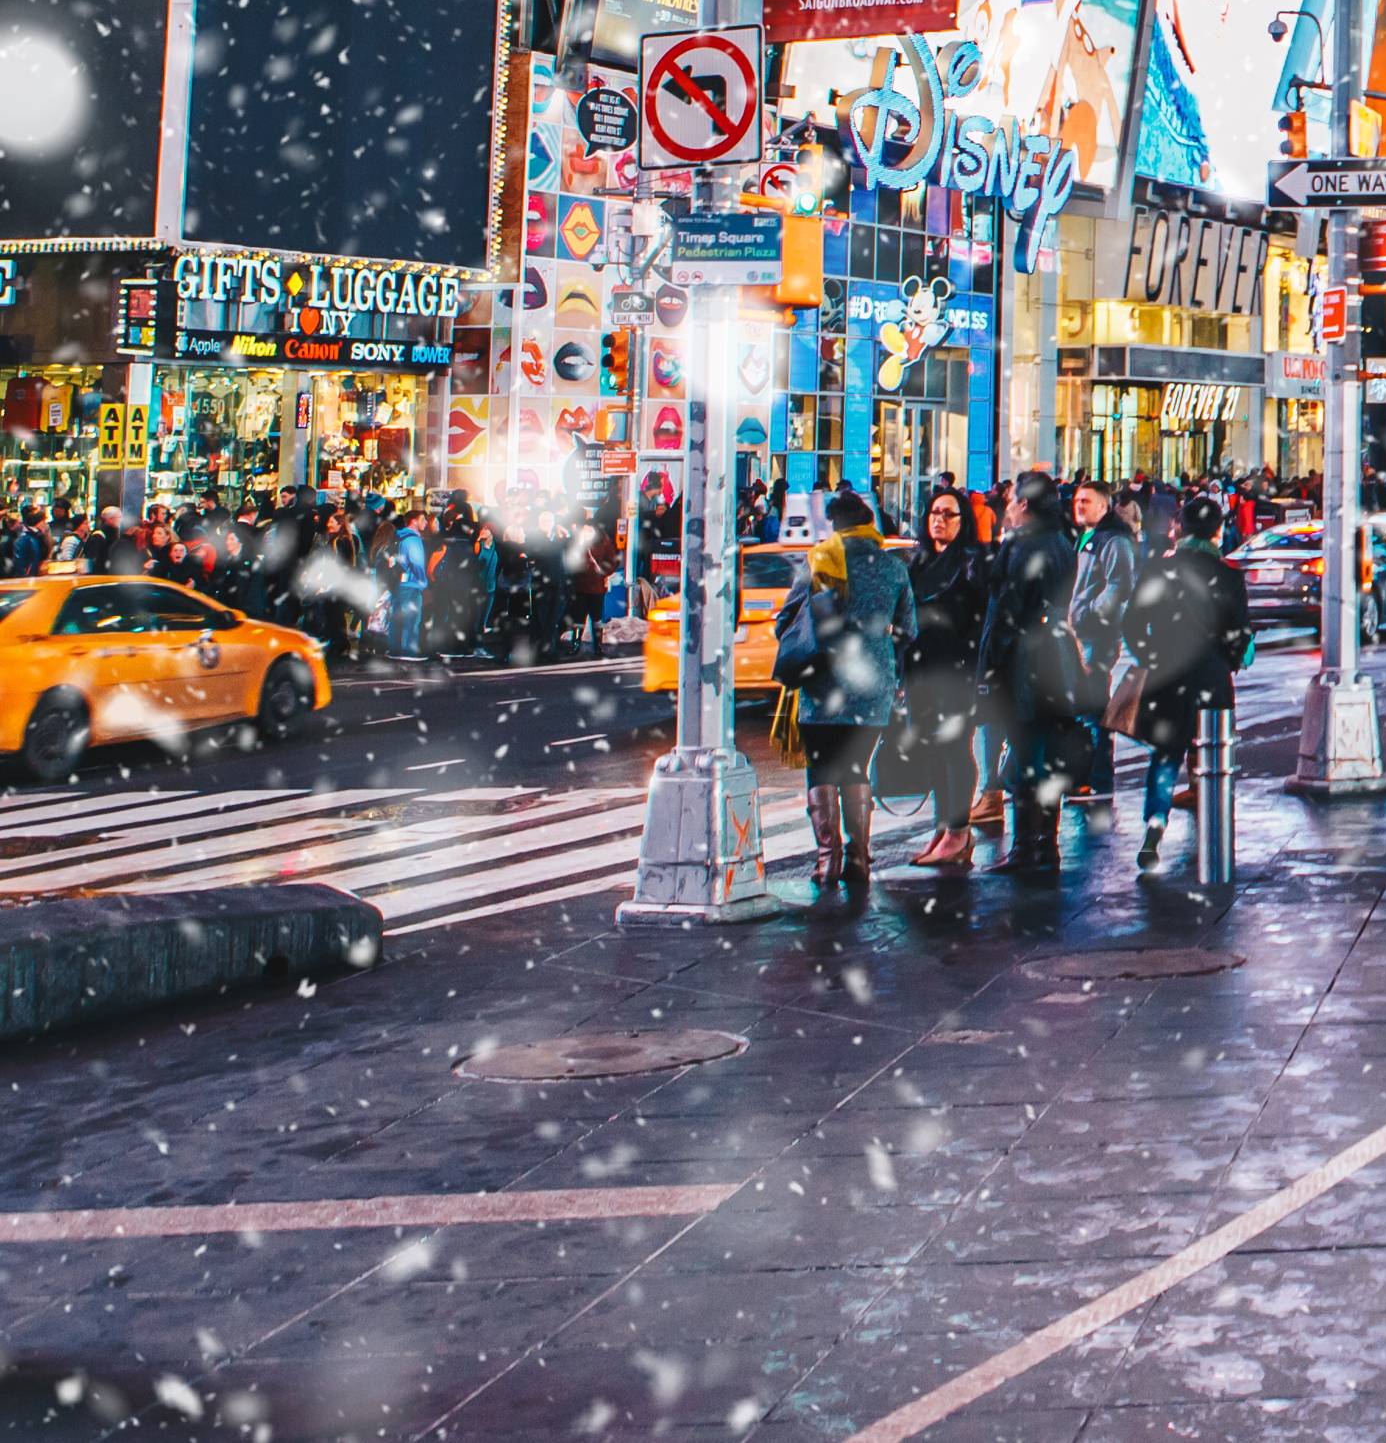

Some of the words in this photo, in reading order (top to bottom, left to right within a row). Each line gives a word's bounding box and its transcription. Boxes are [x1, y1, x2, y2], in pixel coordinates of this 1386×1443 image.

[1311, 172, 1350, 193] ONE
[678, 247, 742, 258] Pedestrian
[745, 247, 777, 258] Plaza
[719, 232, 765, 245] Square
[174, 256, 282, 305] GIFTS
[309, 264, 461, 319] LUGGAGE
[320, 310, 356, 336] NY
[189, 337, 221, 355] Apple
[231, 335, 278, 357] Nikon
[285, 338, 340, 360] Canon
[352, 343, 405, 362] SONY
[411, 346, 452, 364] BOWER
[1160, 383, 1224, 421] FOREVER
[1225, 386, 1240, 421] 21
[104, 407, 120, 459] ATM
[131, 407, 146, 459] ATM
